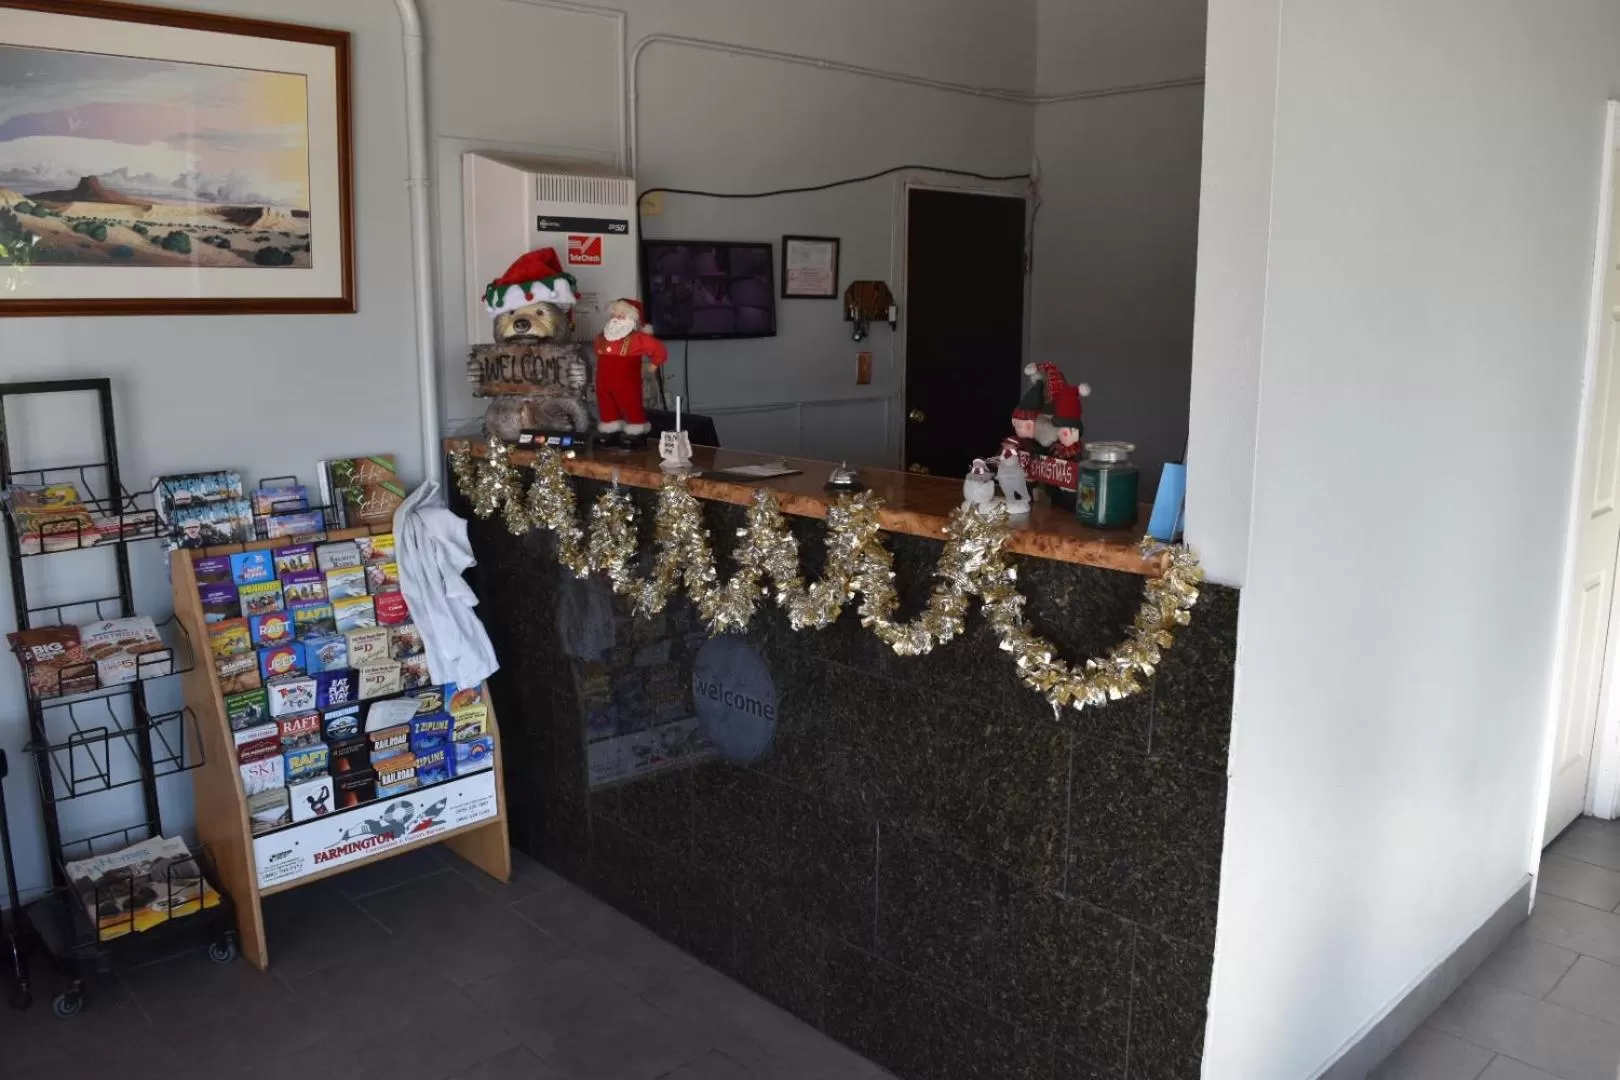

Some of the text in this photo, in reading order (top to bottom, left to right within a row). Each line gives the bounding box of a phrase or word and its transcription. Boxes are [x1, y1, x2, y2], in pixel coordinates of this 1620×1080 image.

[483, 353, 567, 386] WELCOME
[1030, 460, 1072, 484] CHRISTMAS
[259, 621, 290, 636] RAFT
[31, 642, 63, 653] BIG
[328, 685, 350, 695] PLAY
[331, 678, 348, 688] EAT
[329, 692, 349, 702] STAY
[694, 674, 774, 721] welcome
[283, 715, 318, 733] RAFT
[374, 734, 407, 750] RAILROAD
[289, 750, 328, 769] RAFT
[381, 767, 415, 786] RAILROAD
[313, 831, 395, 865] FARMINGTON
